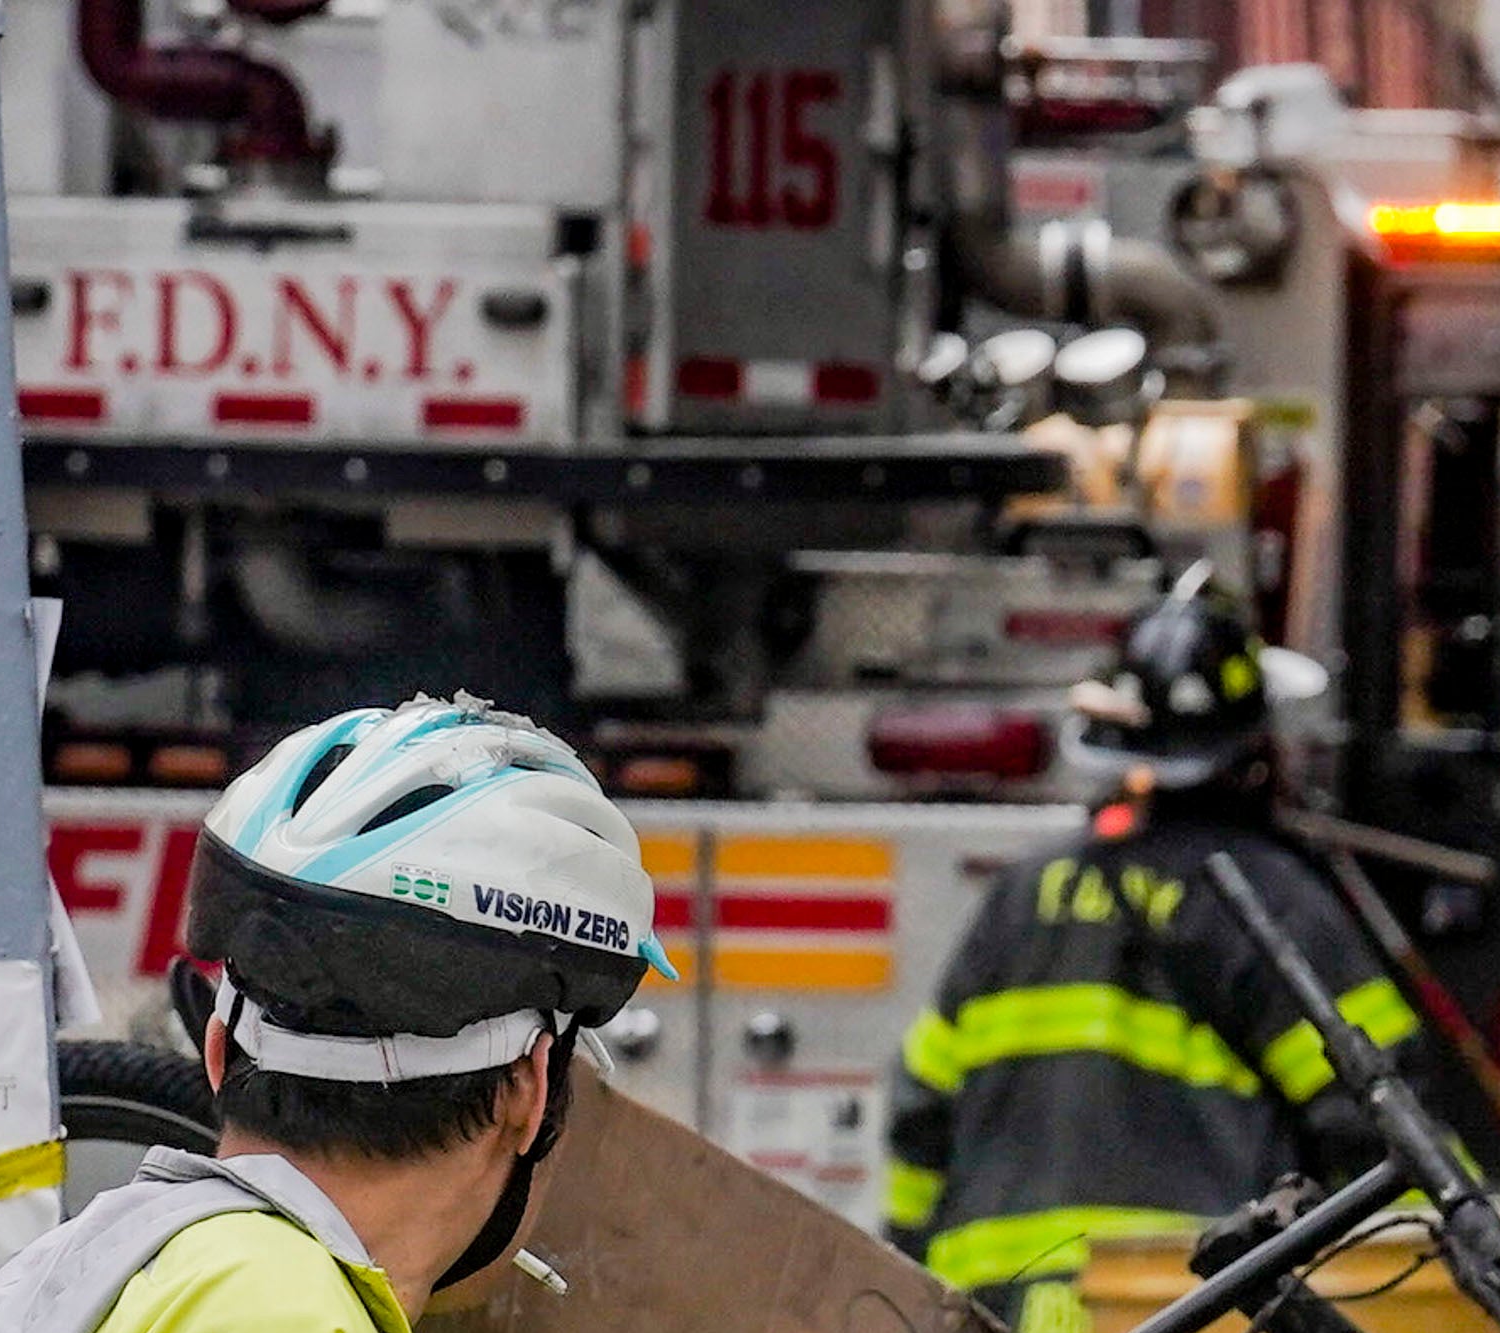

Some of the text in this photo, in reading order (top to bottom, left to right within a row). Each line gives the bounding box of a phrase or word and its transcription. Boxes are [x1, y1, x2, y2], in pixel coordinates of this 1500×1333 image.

[706, 72, 844, 232] 115
[62, 270, 475, 382] F.D.N.Y.
[392, 873, 450, 904] DOT
[473, 884, 631, 950] VISION ZERO
